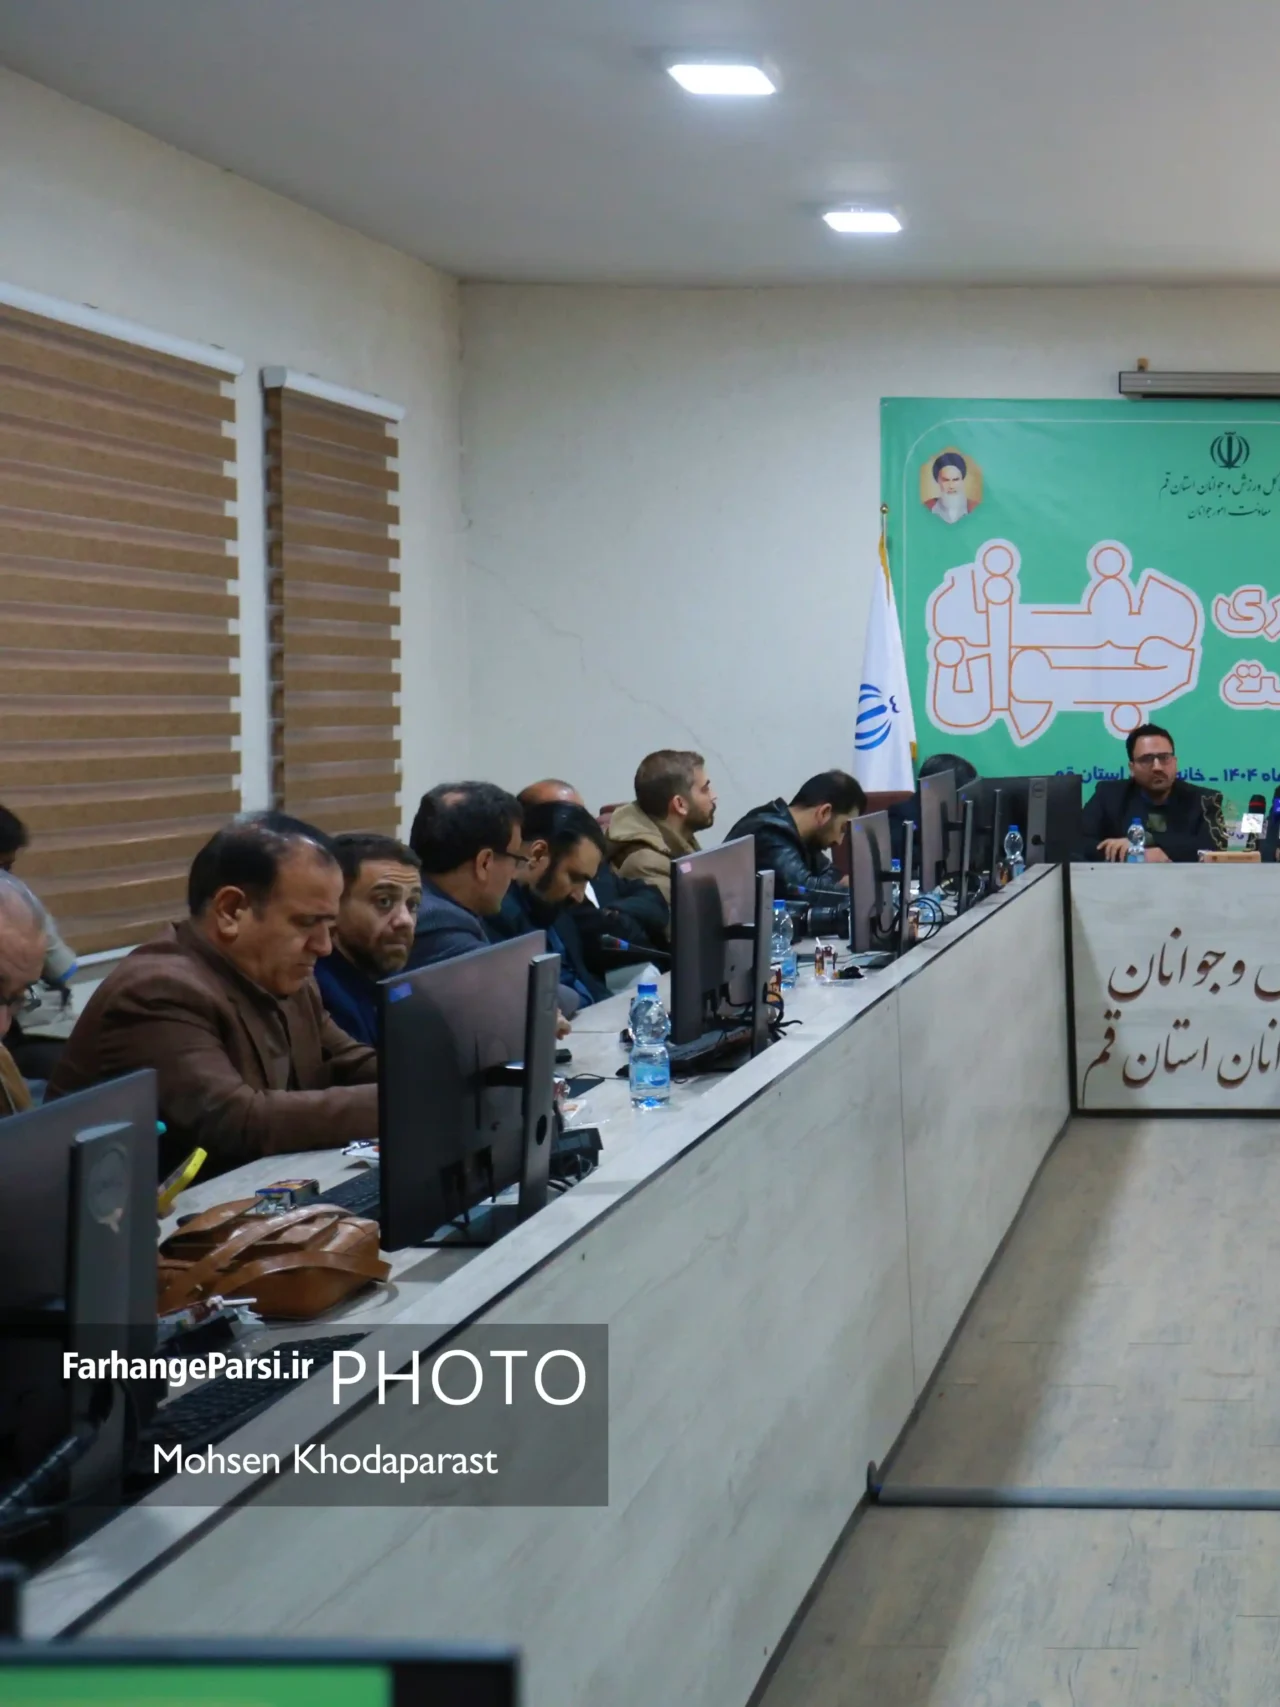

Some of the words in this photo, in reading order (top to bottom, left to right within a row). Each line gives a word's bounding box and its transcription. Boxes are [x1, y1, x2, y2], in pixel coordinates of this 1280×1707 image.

[1158, 471, 1172, 501] قم
[1169, 475, 1196, 496] استان
[1196, 475, 1225, 498] جوانان
[1231, 472, 1262, 496] ورزش
[1187, 504, 1213, 520] جوانان
[1227, 502, 1271, 517] معاونت
[1082, 765, 1124, 784] استان
[1176, 766, 1206, 782] خانه
[1223, 767, 1258, 782] ۱۴۰۴
[1108, 926, 1227, 1003] جوانان
[1227, 959, 1246, 988] و
[1082, 1008, 1122, 1108] قم
[1122, 1018, 1210, 1090] استان
